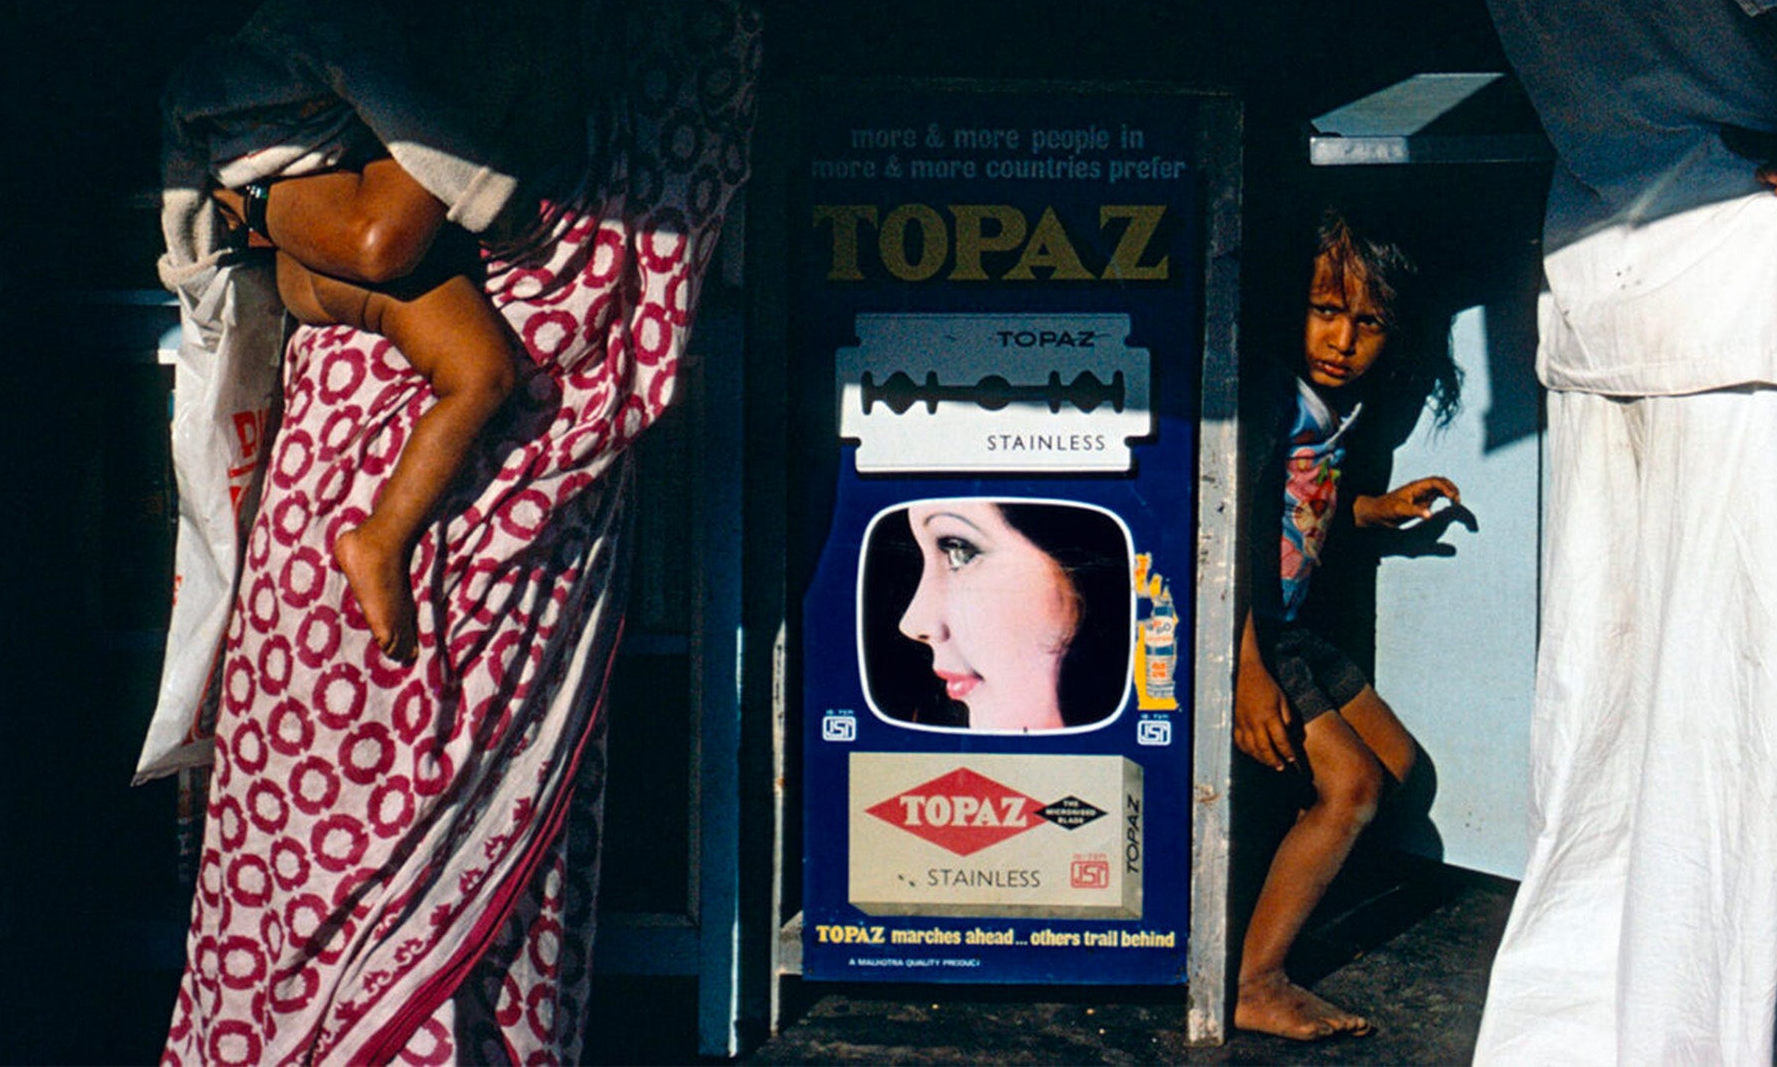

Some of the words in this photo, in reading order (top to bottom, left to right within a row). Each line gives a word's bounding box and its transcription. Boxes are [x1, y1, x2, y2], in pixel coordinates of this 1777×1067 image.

[851, 127, 916, 149] more
[925, 123, 944, 149] &
[954, 127, 1019, 149] more
[1032, 125, 1110, 154] people
[1122, 124, 1144, 149] in
[811, 158, 876, 179] more
[884, 154, 903, 179] &
[911, 158, 976, 179] more
[986, 156, 1101, 179] countries
[1109, 156, 1186, 183] prefer
[814, 203, 1169, 281] TOPAZ
[998, 331, 1095, 347] TOPAZ
[987, 434, 1106, 451] STAINLESS
[899, 795, 1028, 828] TOPAZ
[1126, 795, 1140, 874] TOPAZ
[927, 868, 1041, 888] STAINLESS
[816, 925, 885, 944] TOPAZ
[891, 928, 961, 945] marches
[1030, 928, 1080, 947] others
[1084, 930, 1118, 947] trail
[1121, 930, 1175, 948] behind
[848, 958, 856, 966] A
